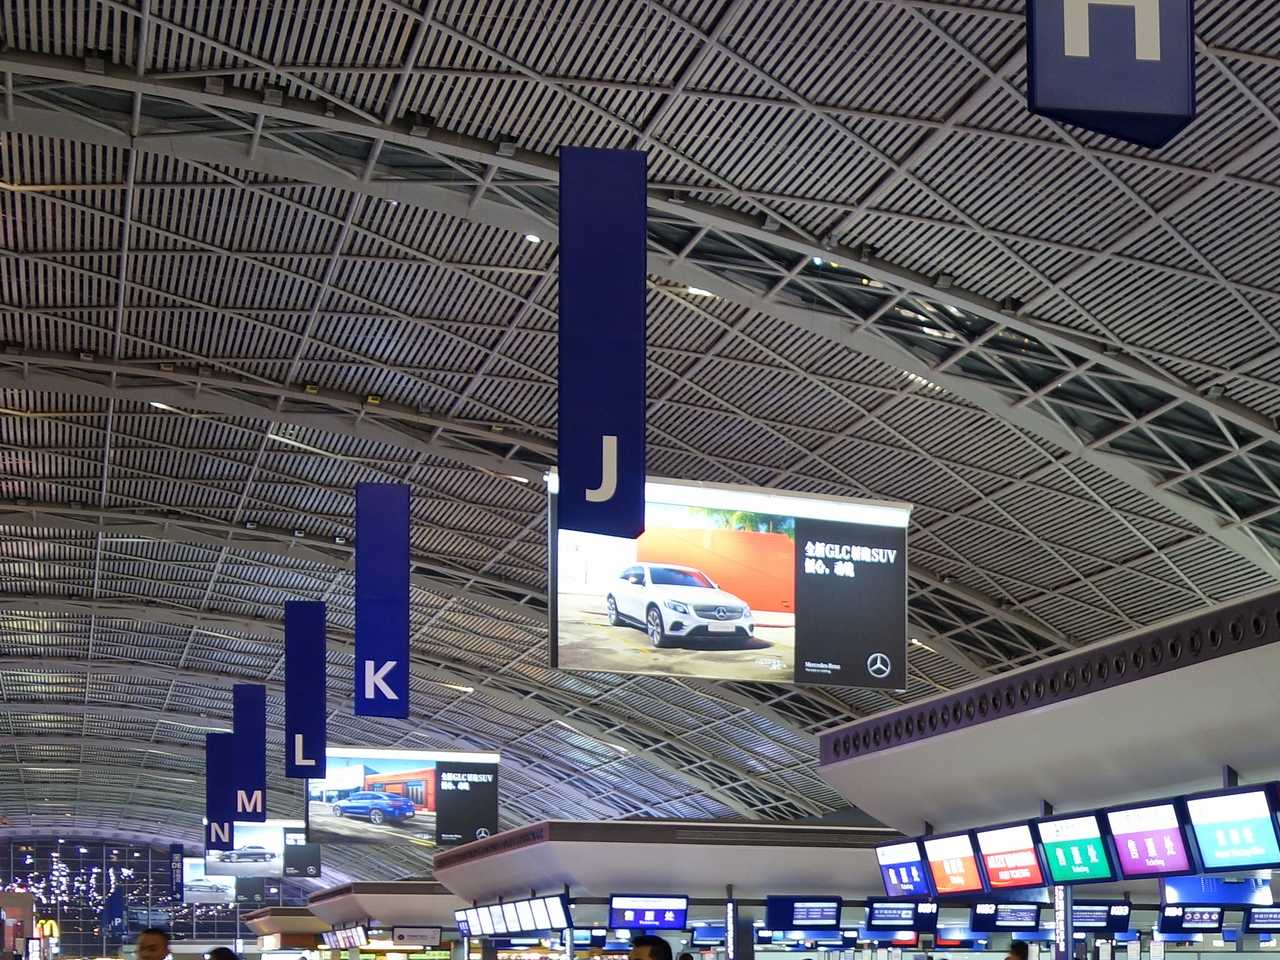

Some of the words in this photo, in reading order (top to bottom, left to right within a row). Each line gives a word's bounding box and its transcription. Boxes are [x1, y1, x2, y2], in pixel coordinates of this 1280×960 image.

[586, 436, 617, 502] J
[365, 660, 399, 700] K
[295, 734, 316, 766] L
[237, 790, 262, 813] M
[210, 822, 230, 842] N
